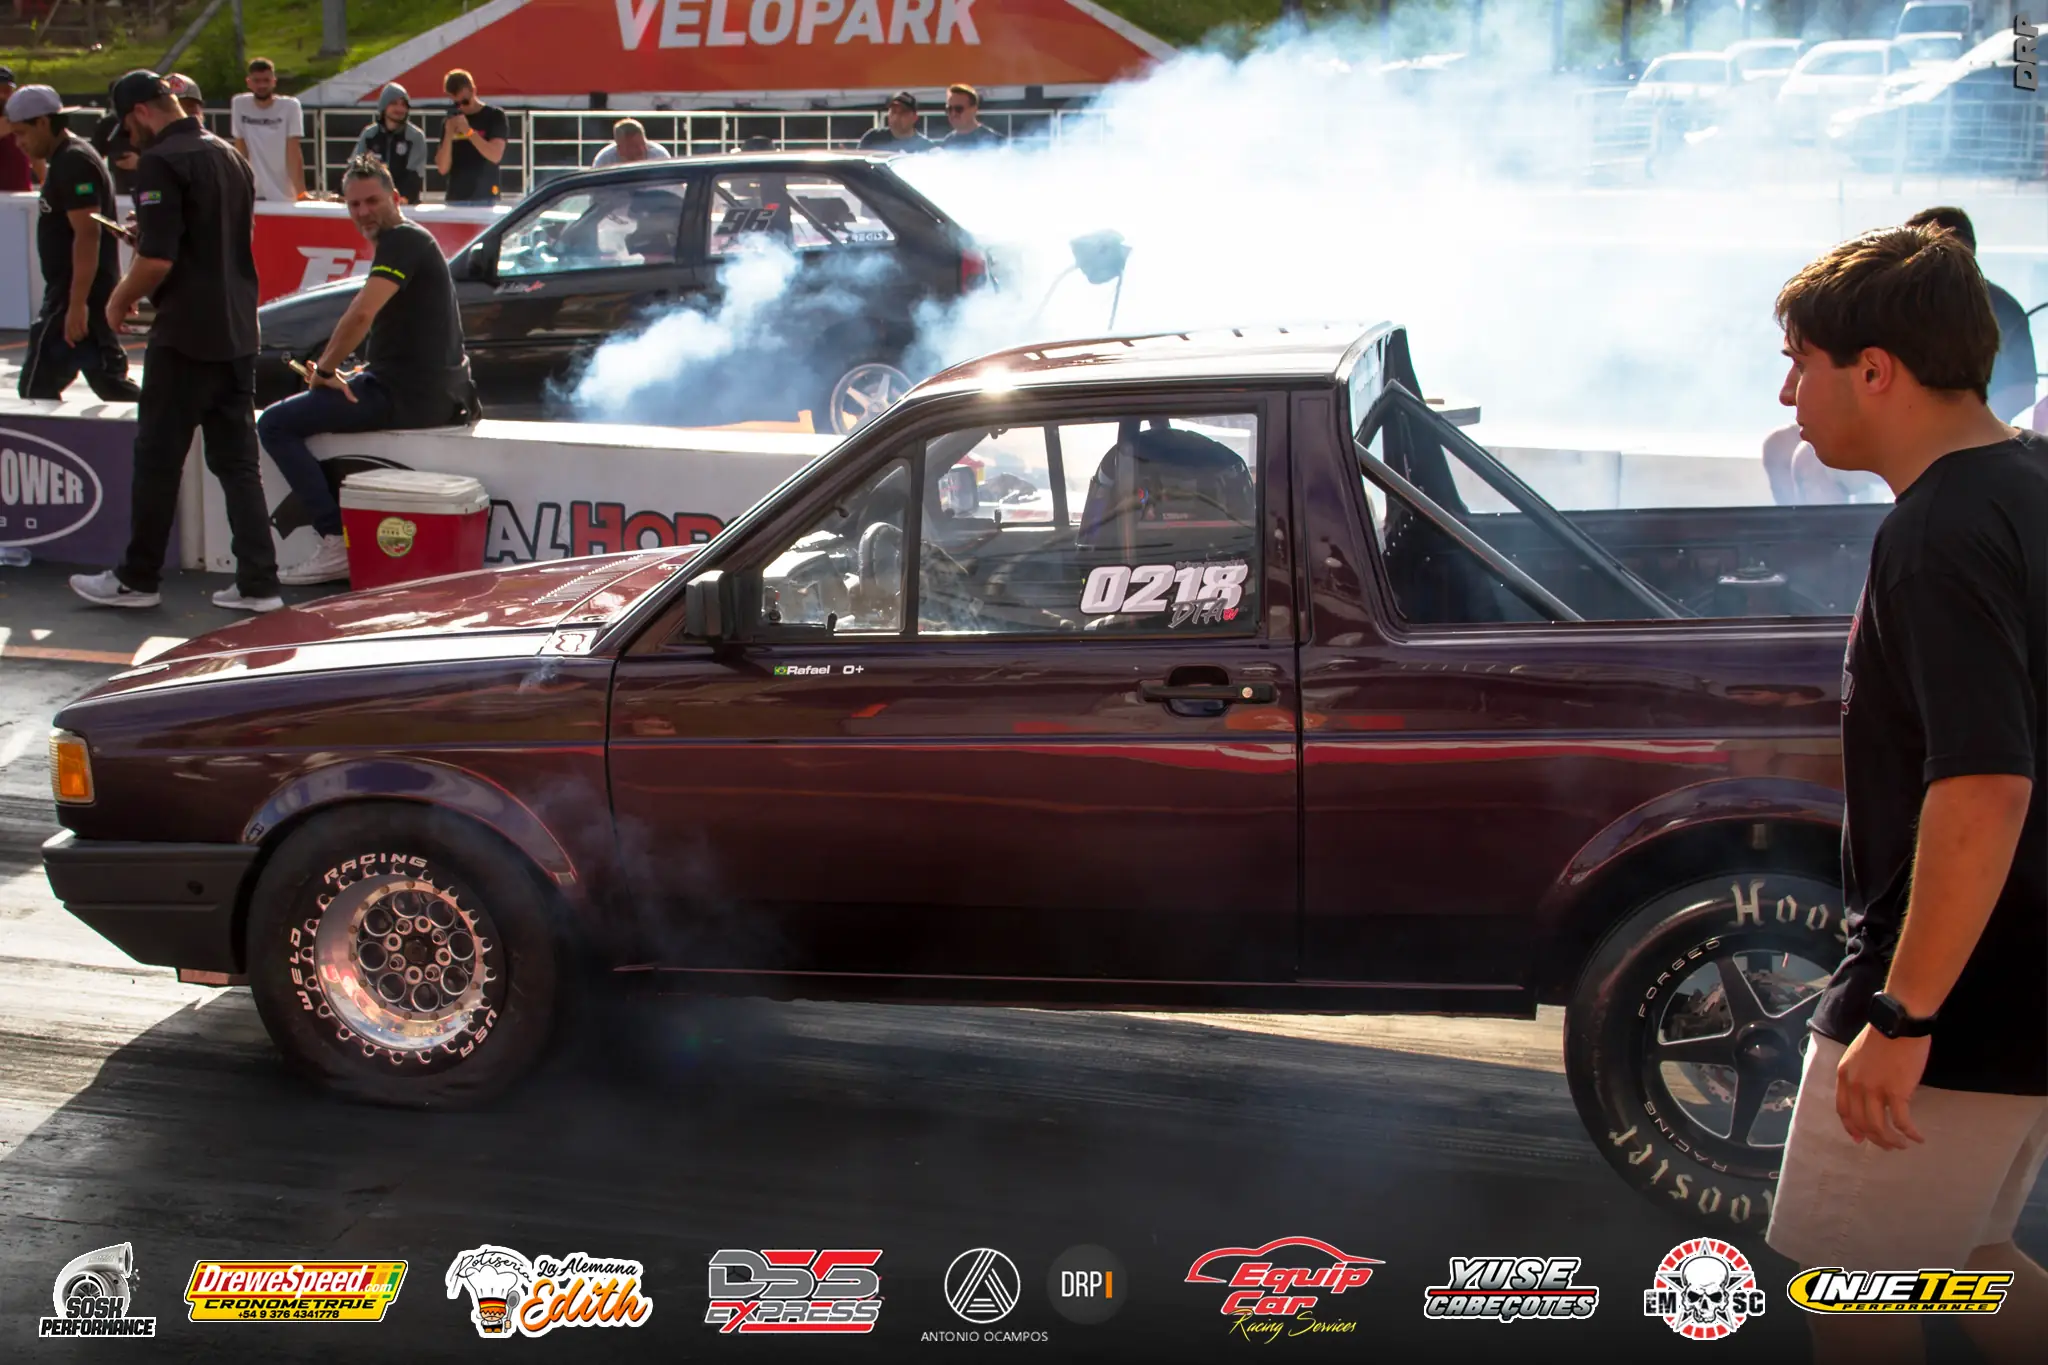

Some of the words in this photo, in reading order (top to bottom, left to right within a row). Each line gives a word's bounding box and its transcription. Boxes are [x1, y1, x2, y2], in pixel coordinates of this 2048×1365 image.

[615, 0, 981, 50] VELOPARK
[1079, 564, 1249, 614] 0218
[1168, 596, 1228, 629] DTA
[786, 665, 831, 676] Rafael
[289, 927, 314, 1010] WELD
[323, 852, 428, 885] RACING
[1638, 939, 1720, 1018] FORGED
[459, 1009, 498, 1058] USA
[1644, 1100, 1728, 1173] RACING
